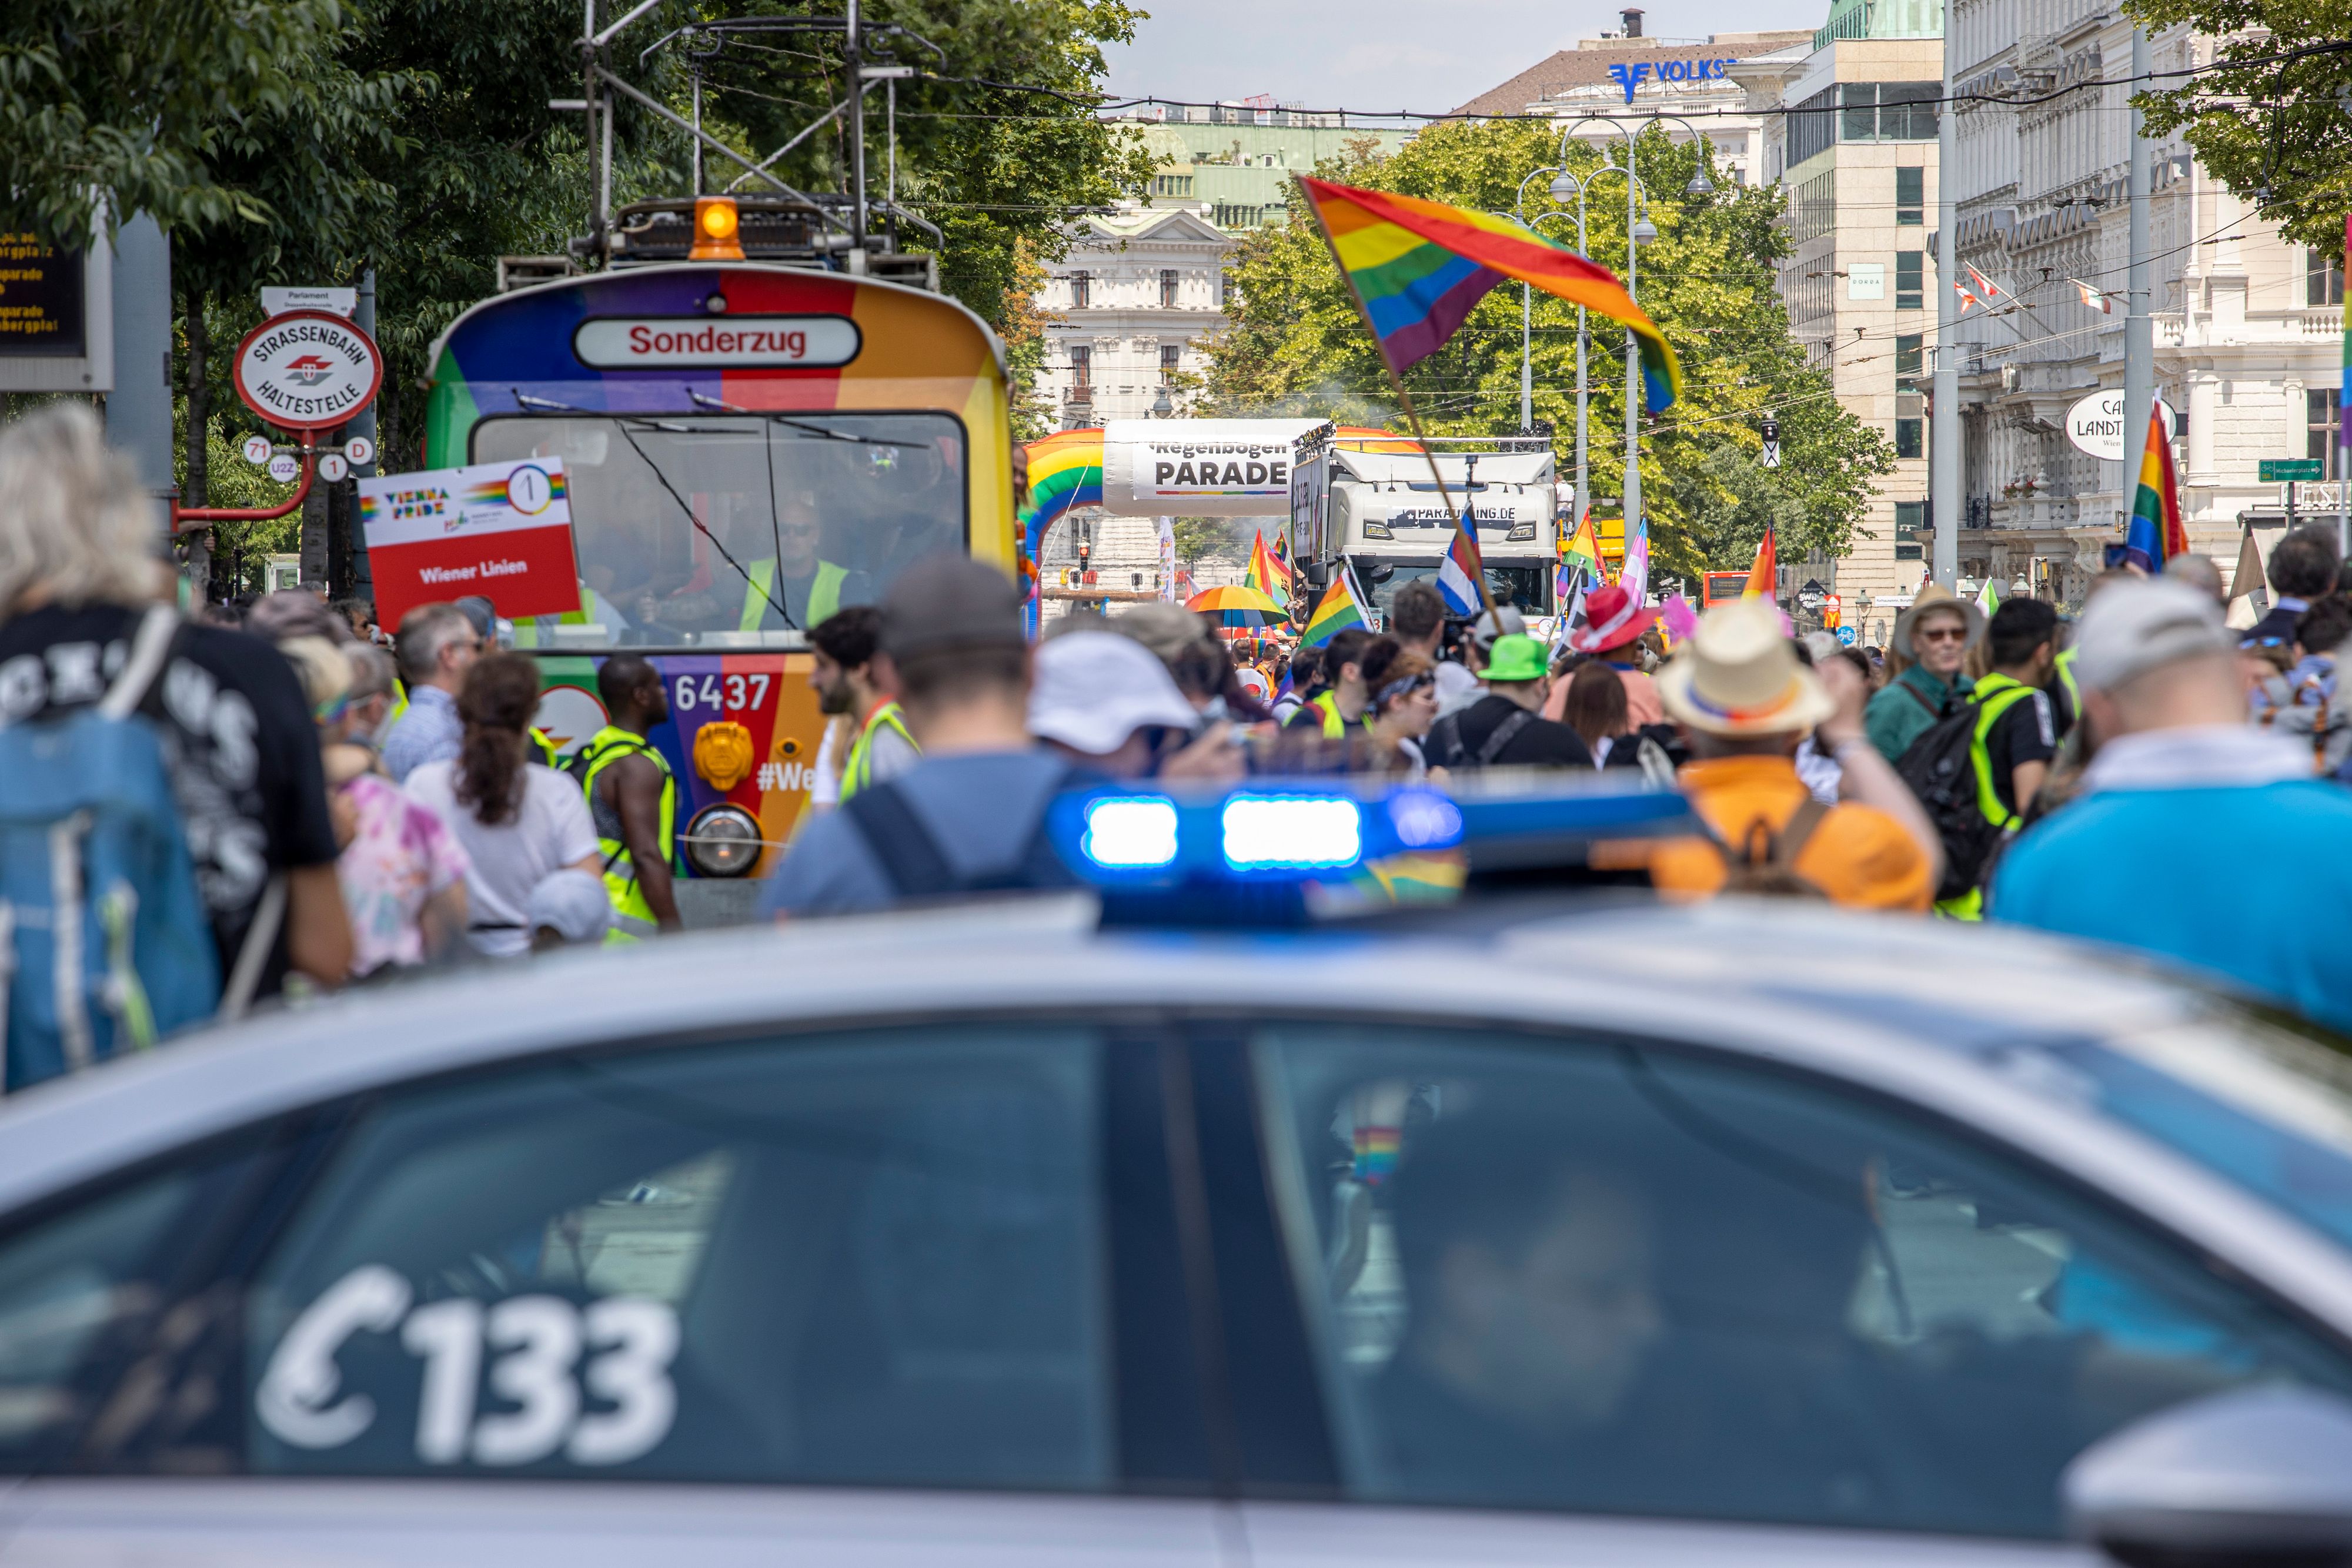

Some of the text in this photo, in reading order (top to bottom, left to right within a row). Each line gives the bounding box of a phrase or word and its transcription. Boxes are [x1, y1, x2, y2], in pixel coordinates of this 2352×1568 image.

[288, 291, 329, 299] Parlament
[253, 326, 366, 366] STRASSENBAHN
[629, 325, 806, 359] Sonderzug
[257, 380, 360, 414] HALTESTELLE
[2077, 420, 2126, 436] LANDT
[249, 443, 266, 458] 71
[352, 444, 365, 457] D
[271, 463, 294, 473] U2Z
[330, 460, 337, 474] 1
[1155, 462, 1288, 486] PARADE
[385, 487, 449, 504] VIENNA
[393, 502, 445, 520] PRIDE
[419, 559, 527, 584] Wiener Linien
[675, 674, 770, 711] 6437
[400, 1294, 681, 1466] 133
